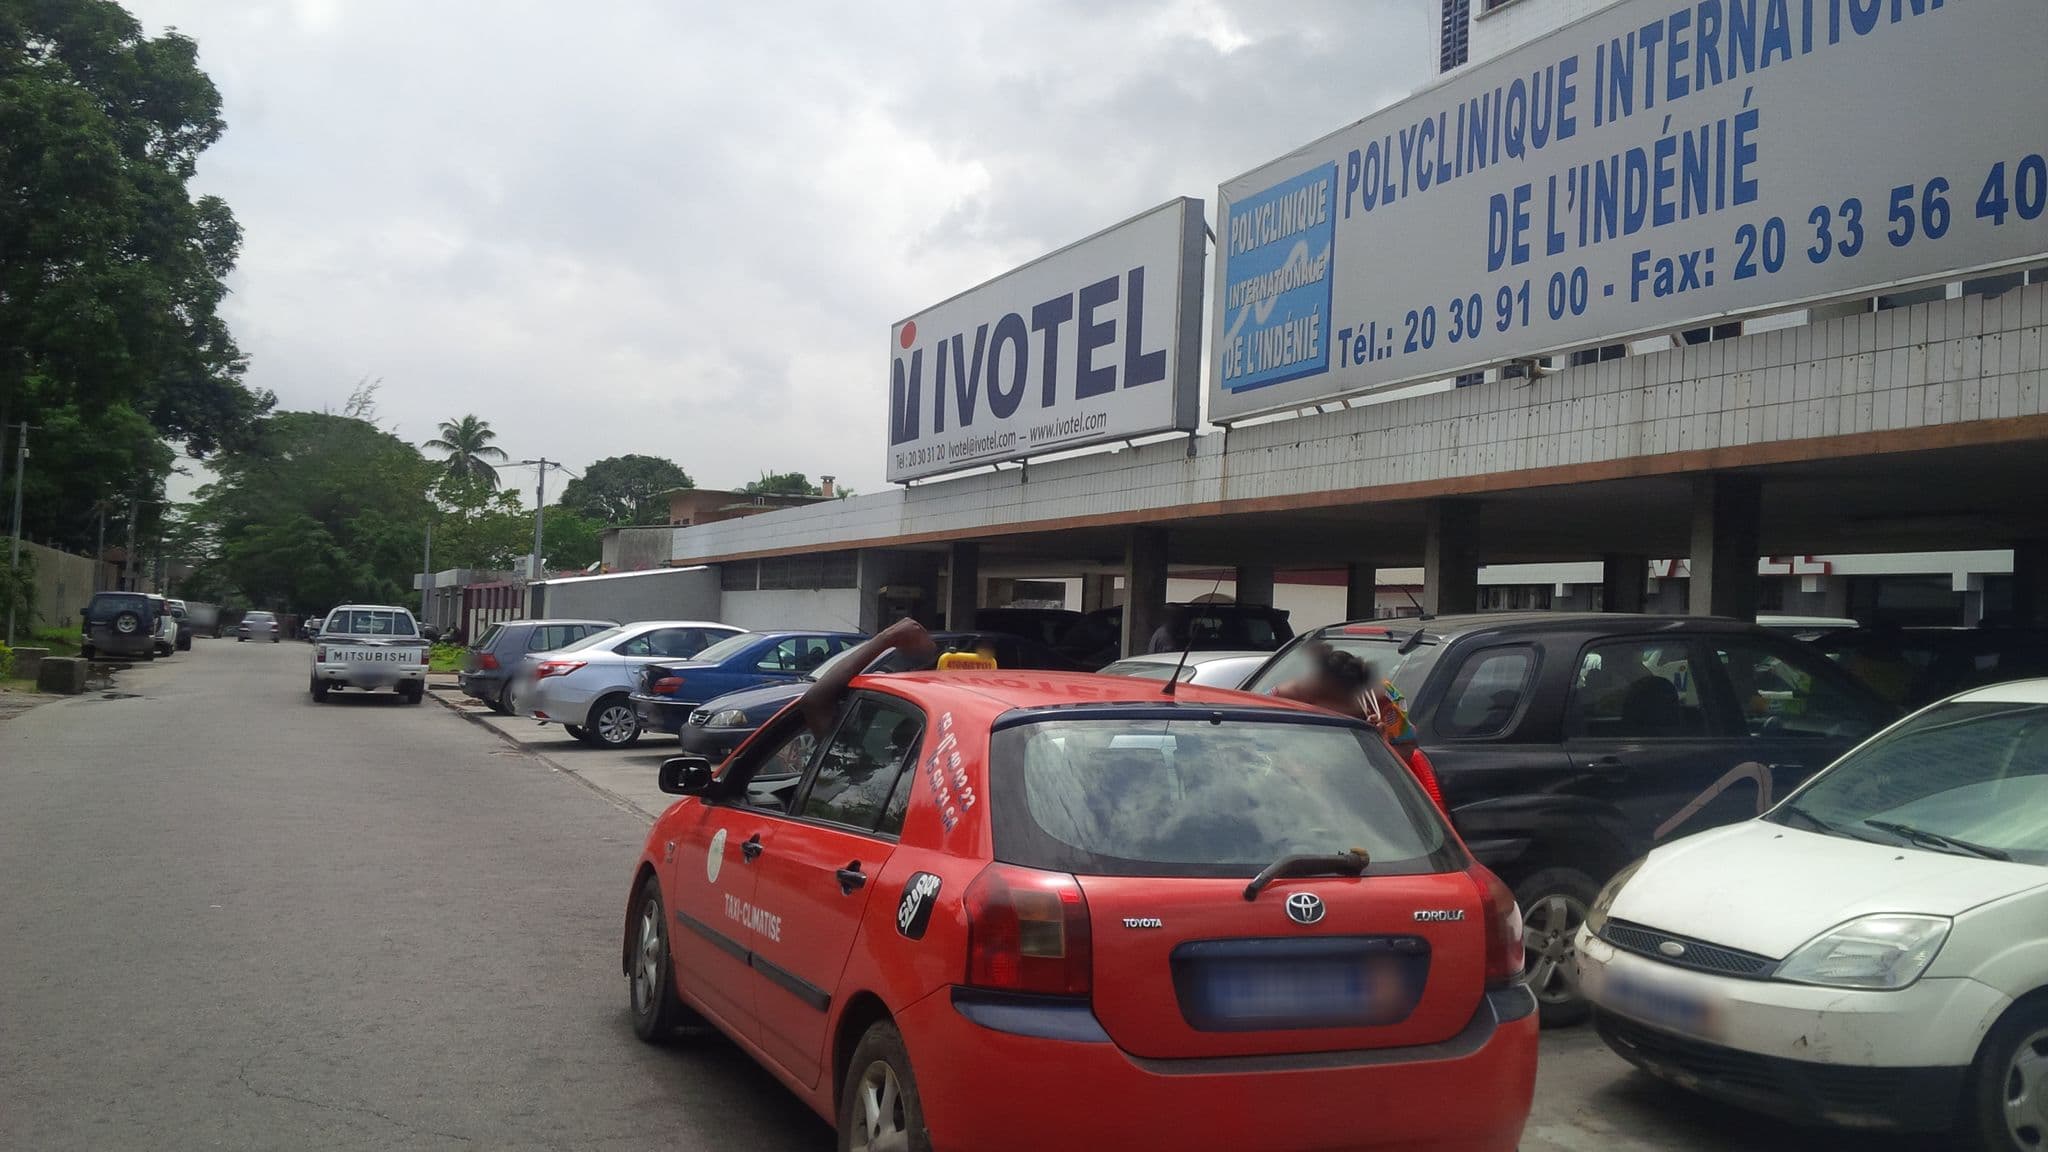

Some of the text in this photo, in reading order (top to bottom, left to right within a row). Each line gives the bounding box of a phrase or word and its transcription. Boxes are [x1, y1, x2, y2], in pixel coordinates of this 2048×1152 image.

[1345, 55, 1578, 219] POLYCLINIQUE
[1488, 86, 1759, 272] DE L'INDÉNIÉ
[1230, 179, 1328, 257] POLYCLINIQUE
[1403, 306, 1436, 354] 20
[1448, 293, 1483, 344] 30
[1495, 279, 1530, 332] 91
[1548, 266, 1588, 321] 00
[1631, 247, 1715, 303] Fax:
[1733, 216, 1786, 281] 20
[1807, 197, 1864, 264] 33
[1887, 177, 1950, 247] 56
[1975, 153, 2047, 226] 40
[1229, 255, 1325, 311] INTERNATIONALE
[934, 265, 1167, 435] IVOTEL
[1225, 303, 1320, 380] DE L'INDÉNIÉ
[908, 452, 917, 467] 20
[917, 450, 926, 465] 30
[926, 446, 935, 463] 31
[936, 443, 945, 461] 20
[1030, 411, 1107, 442] www.ivotel.com
[333, 651, 413, 662] MITSUBISHI
[1122, 918, 1163, 928] TOYOTA
[1413, 909, 1465, 921] COROLLA
